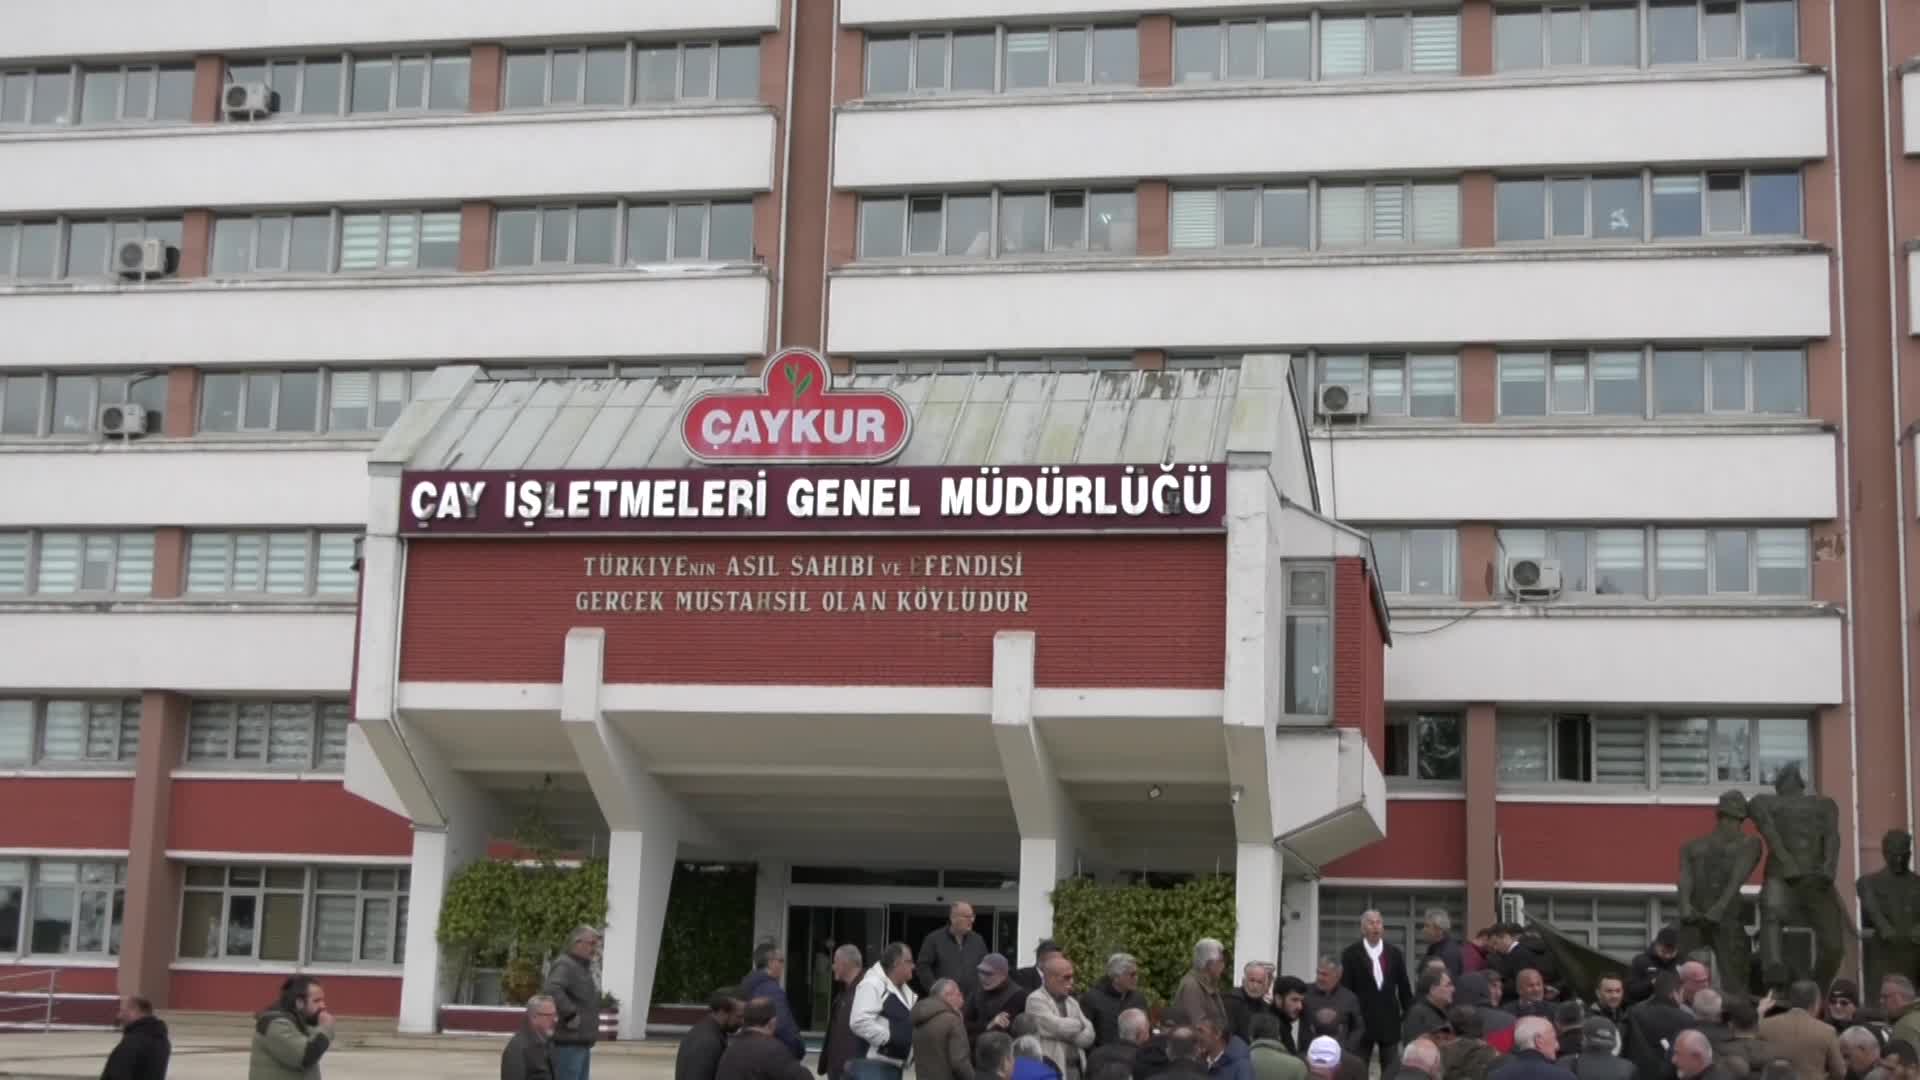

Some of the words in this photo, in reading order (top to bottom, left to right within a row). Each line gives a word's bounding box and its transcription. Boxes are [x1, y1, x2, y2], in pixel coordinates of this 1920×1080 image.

[702, 408, 886, 450] ÇAYKUR
[409, 480, 487, 529] ÇAY
[503, 470, 767, 528] İŞLETMELERİ
[786, 477, 921, 518] GENEL
[940, 462, 1213, 518] MÜDÜRLÜĞÜ
[822, 589, 887, 612] OLAN
